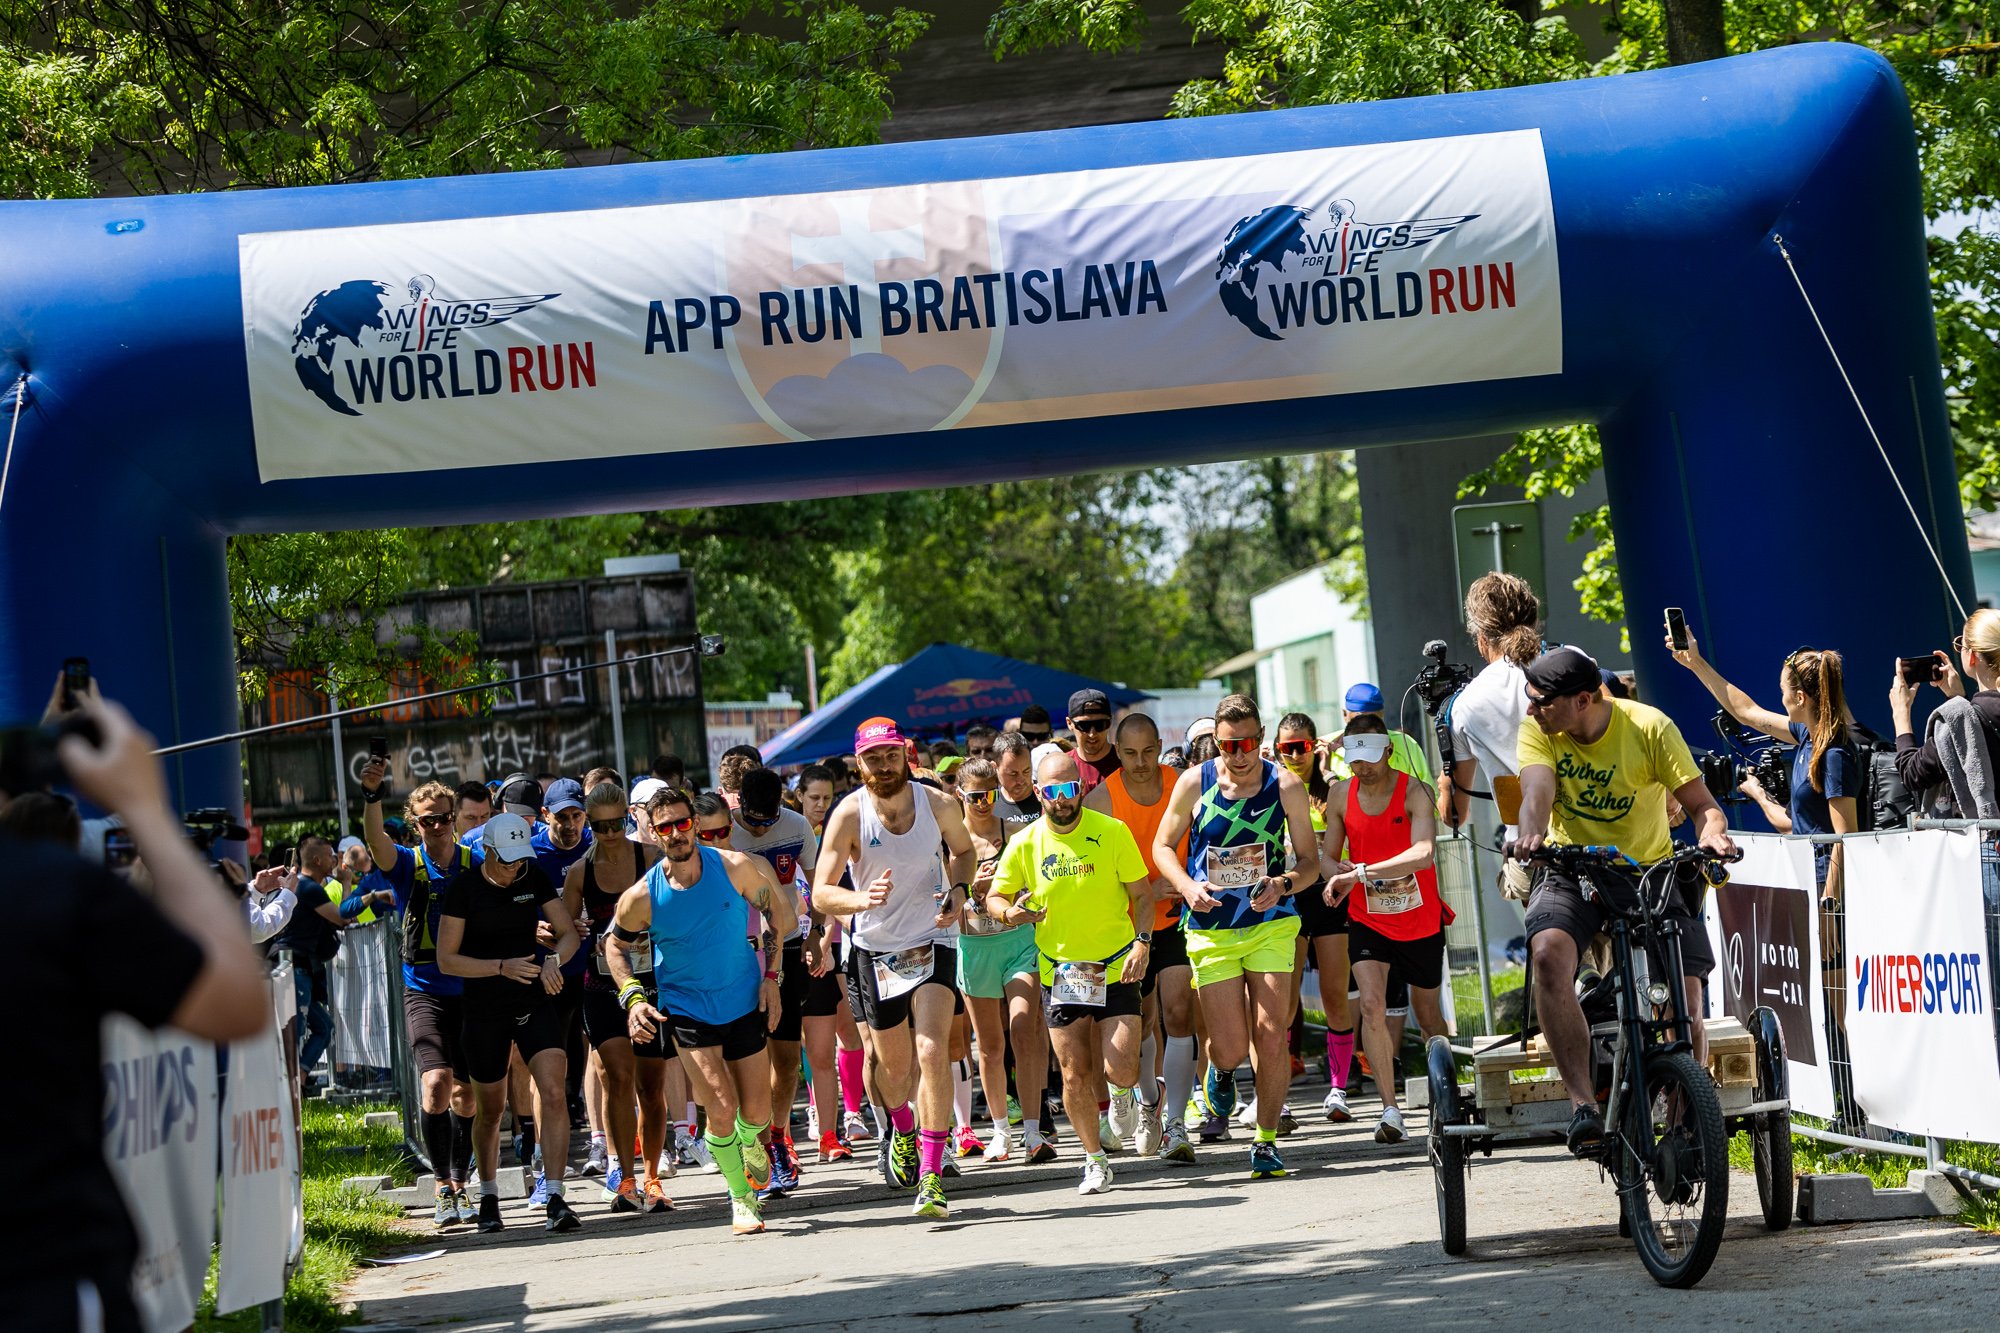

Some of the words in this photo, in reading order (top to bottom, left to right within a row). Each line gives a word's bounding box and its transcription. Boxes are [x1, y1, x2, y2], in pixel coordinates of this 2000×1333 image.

[1302, 256, 1324, 268] FOR
[644, 294, 741, 355] APP
[759, 284, 862, 346] RUN
[878, 259, 1168, 336] BRATISLAVA
[379, 331, 401, 343] FOR
[906, 697, 969, 719] Red
[972, 687, 1033, 709] Bull
[1557, 752, 1617, 788] Švihaj
[1576, 784, 1637, 815] Šuhaj
[1060, 984, 1094, 995] 122111
[1871, 952, 1982, 1015] INTERSPORT
